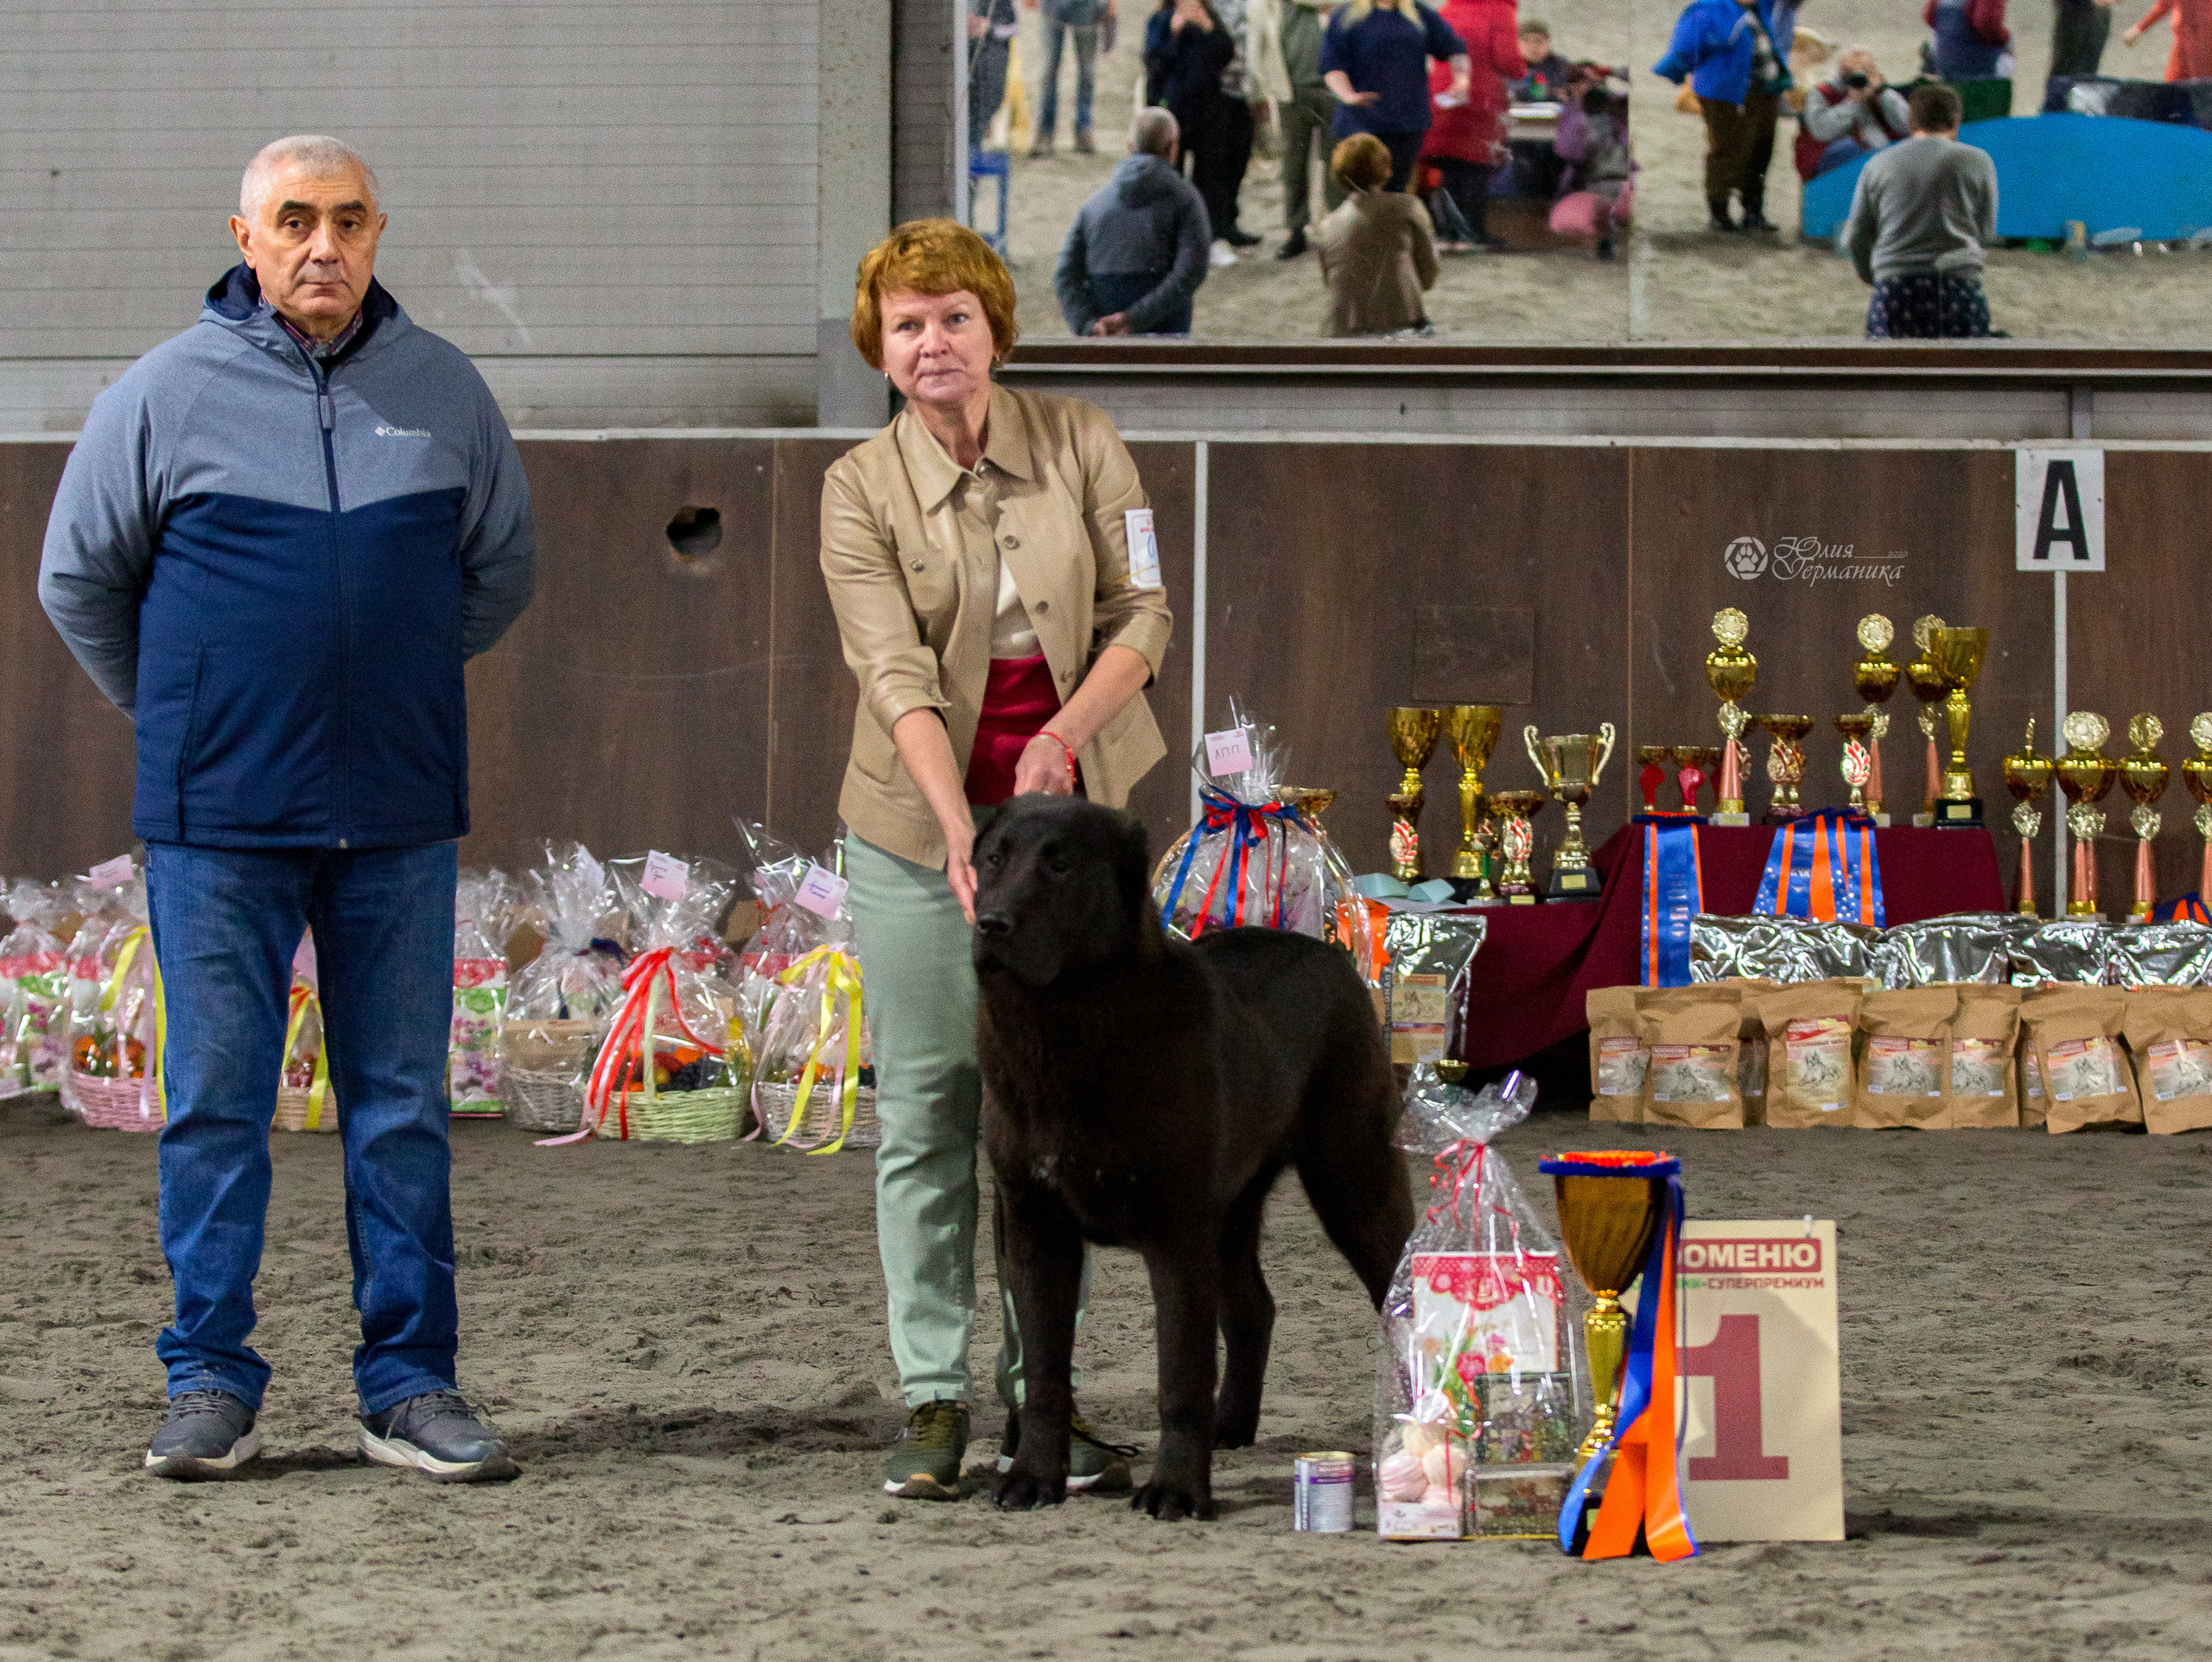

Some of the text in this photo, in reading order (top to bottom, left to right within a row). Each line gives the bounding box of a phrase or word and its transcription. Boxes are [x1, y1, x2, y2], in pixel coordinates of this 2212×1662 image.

[385, 426, 432, 437] Columbia
[2032, 459, 2090, 560] A
[1677, 1242, 1817, 1269] ОМЕНЮ
[1675, 1313, 1789, 1481] 1
